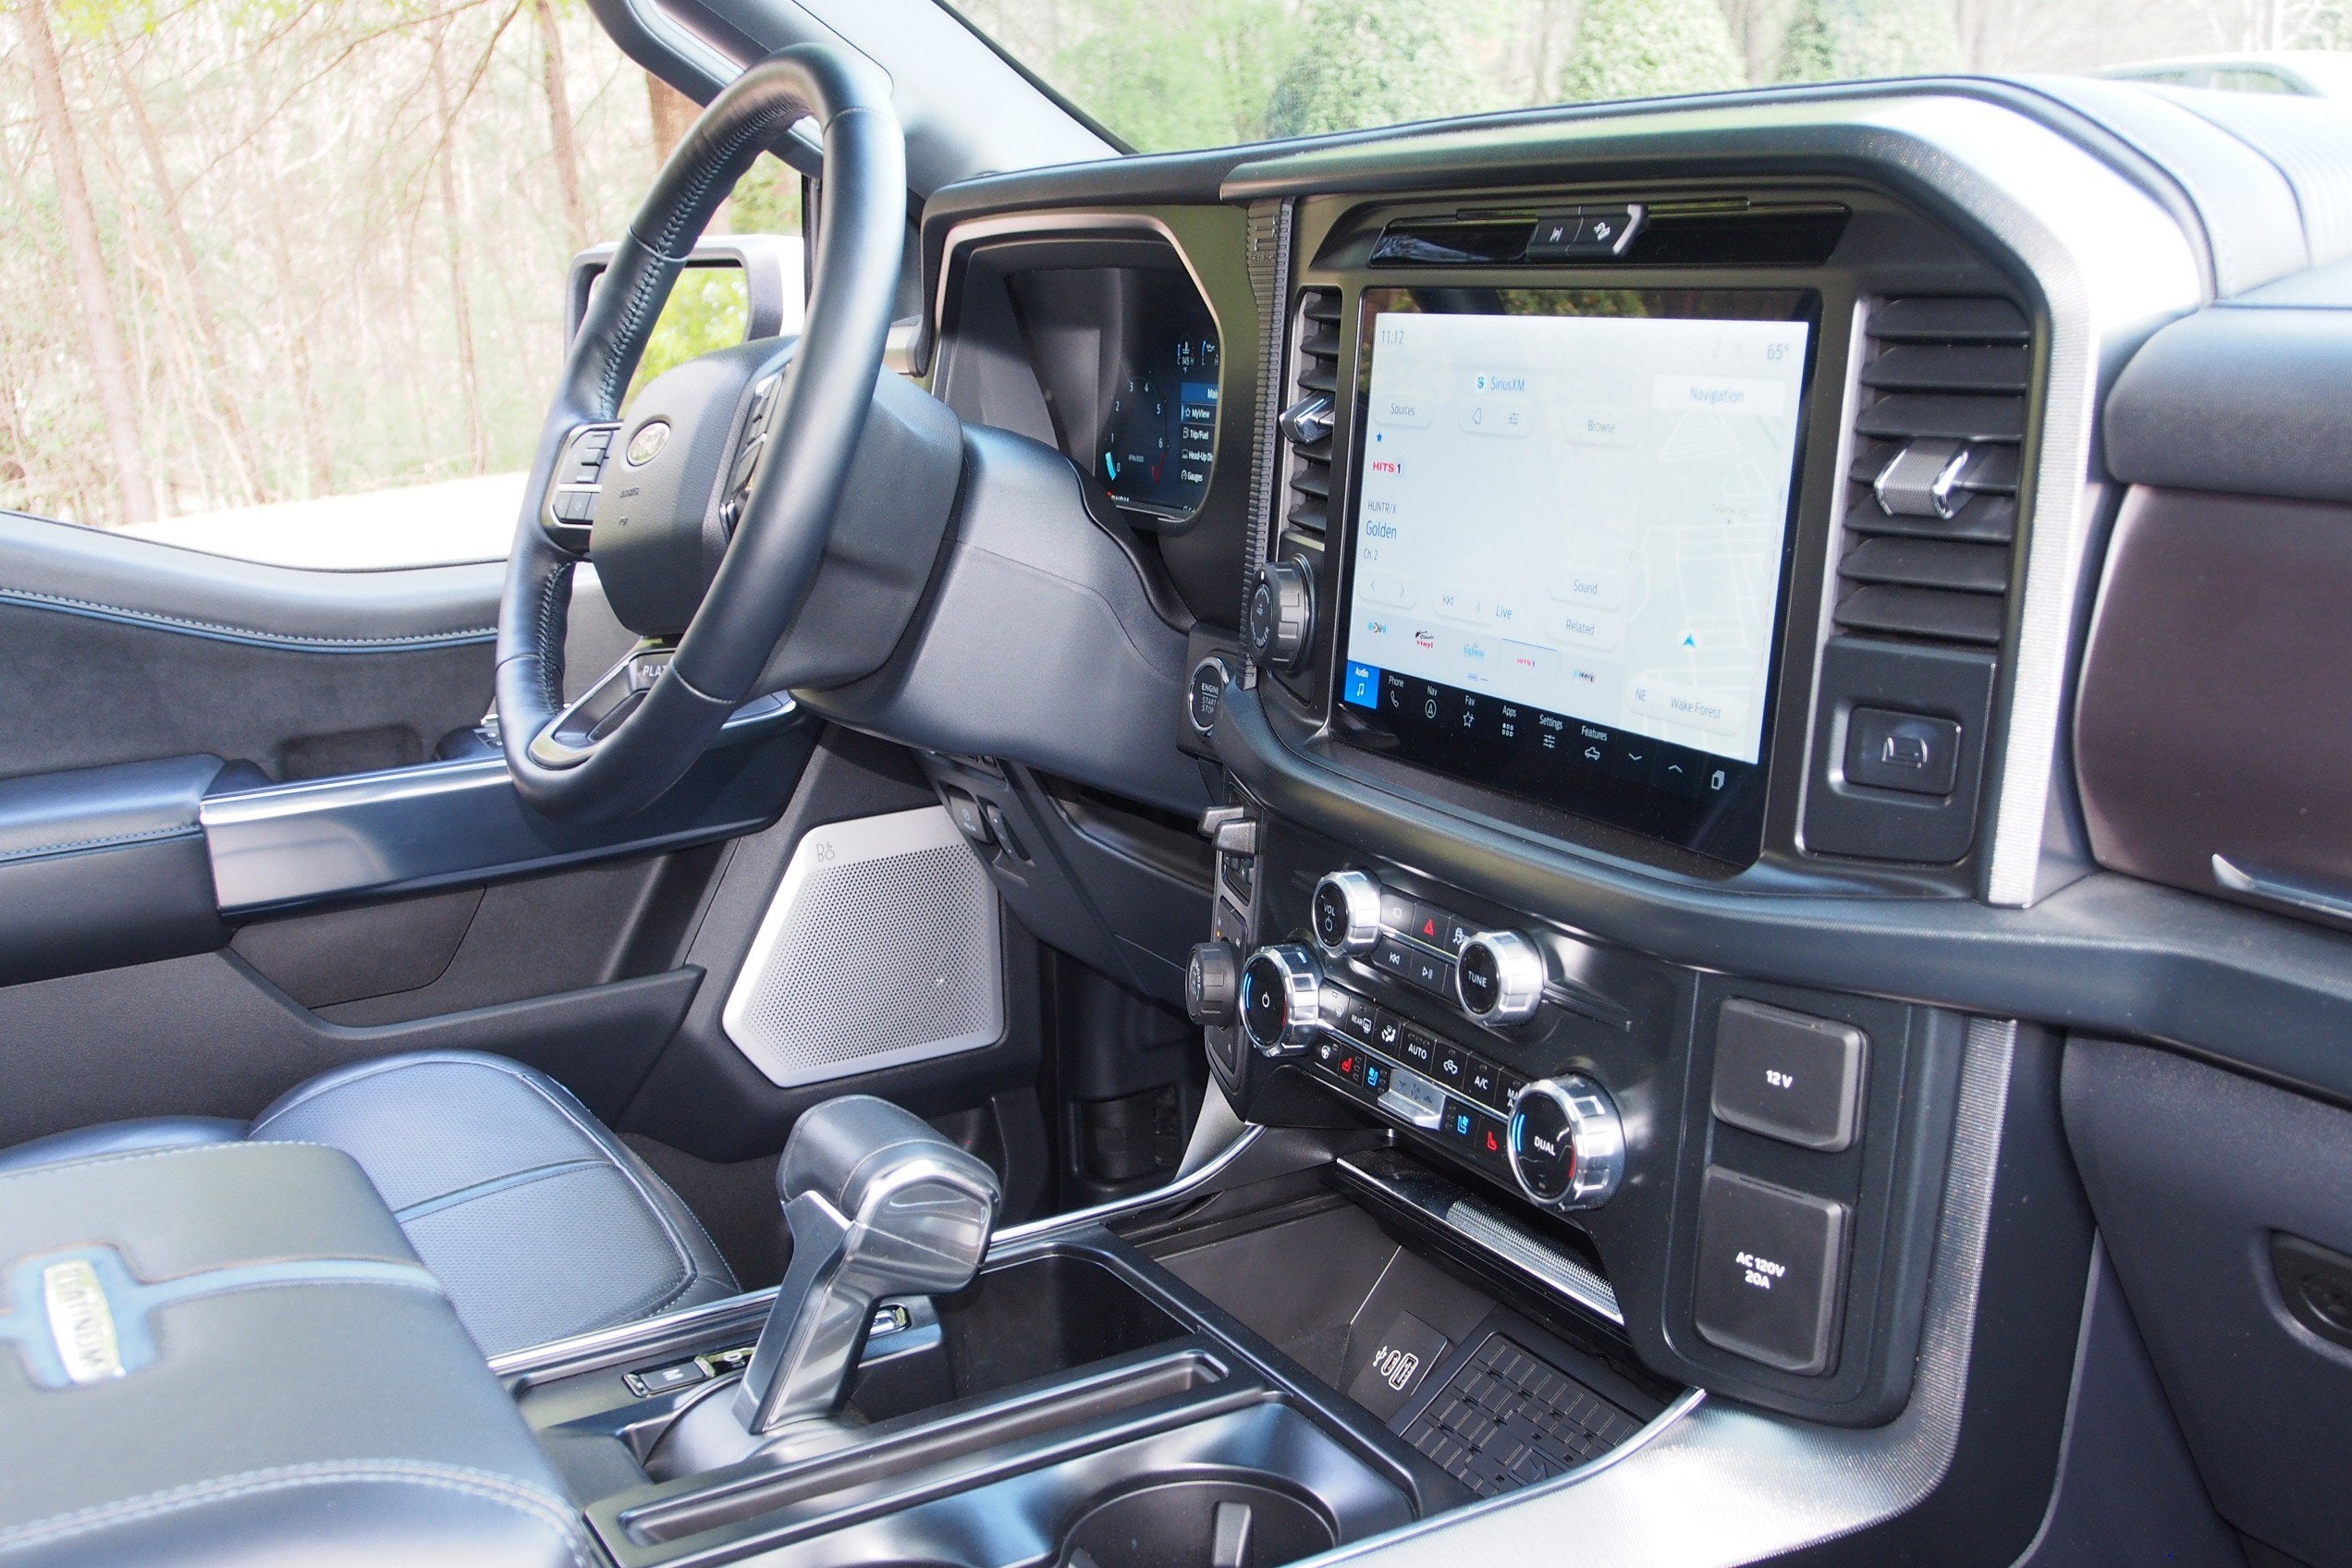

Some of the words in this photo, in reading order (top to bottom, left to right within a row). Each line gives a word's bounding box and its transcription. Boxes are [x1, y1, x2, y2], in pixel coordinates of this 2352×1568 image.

[1380, 329, 1404, 346] 11:12
[1767, 343, 1791, 361] 65°
[1129, 381, 1133, 392] 3
[1144, 382, 1149, 393] 4
[1490, 375, 1525, 392] SiriusXM
[1207, 388, 1219, 398] Mai
[1689, 386, 1745, 405] Navigation
[1115, 401, 1120, 411] 2
[1156, 404, 1161, 415] 5
[1390, 402, 1415, 417] Sources
[1587, 418, 1616, 435] Browse
[1158, 437, 1163, 448] 6
[1116, 462, 1121, 472] 0
[1372, 461, 1395, 473] HITS
[1397, 463, 1402, 474] 1
[1367, 500, 1397, 514] HUNTR/X
[1366, 520, 1397, 540] Golden
[1374, 549, 1378, 561] 2
[1574, 579, 1599, 596] Sound
[1496, 606, 1513, 620] Live
[1565, 619, 1596, 637] Related
[1354, 667, 1369, 679] Audio
[1201, 682, 1219, 694] ENGINE
[1389, 675, 1404, 687] Phone
[1427, 685, 1438, 696] Nav
[1635, 687, 1648, 703] NE
[1201, 696, 1217, 706] START
[1464, 695, 1476, 706] Fav
[1671, 696, 1694, 713] Wake
[1695, 701, 1721, 719] Forest
[1201, 704, 1215, 714] STOP
[1502, 705, 1517, 717] Apps
[1539, 715, 1563, 730] Settings
[1581, 725, 1608, 741] Features
[1322, 903, 1336, 917] VOL
[1467, 970, 1488, 988] TUNE
[1351, 1014, 1364, 1027] REAR
[1407, 1043, 1427, 1060] AUTO
[1474, 1075, 1488, 1091] A/C
[1507, 1087, 1519, 1100] MA
[1534, 1135, 1556, 1157] DUAL
[1735, 1251, 1754, 1268] AC
[1755, 1257, 1786, 1278] 120V
[1745, 1269, 1770, 1290] 20A
